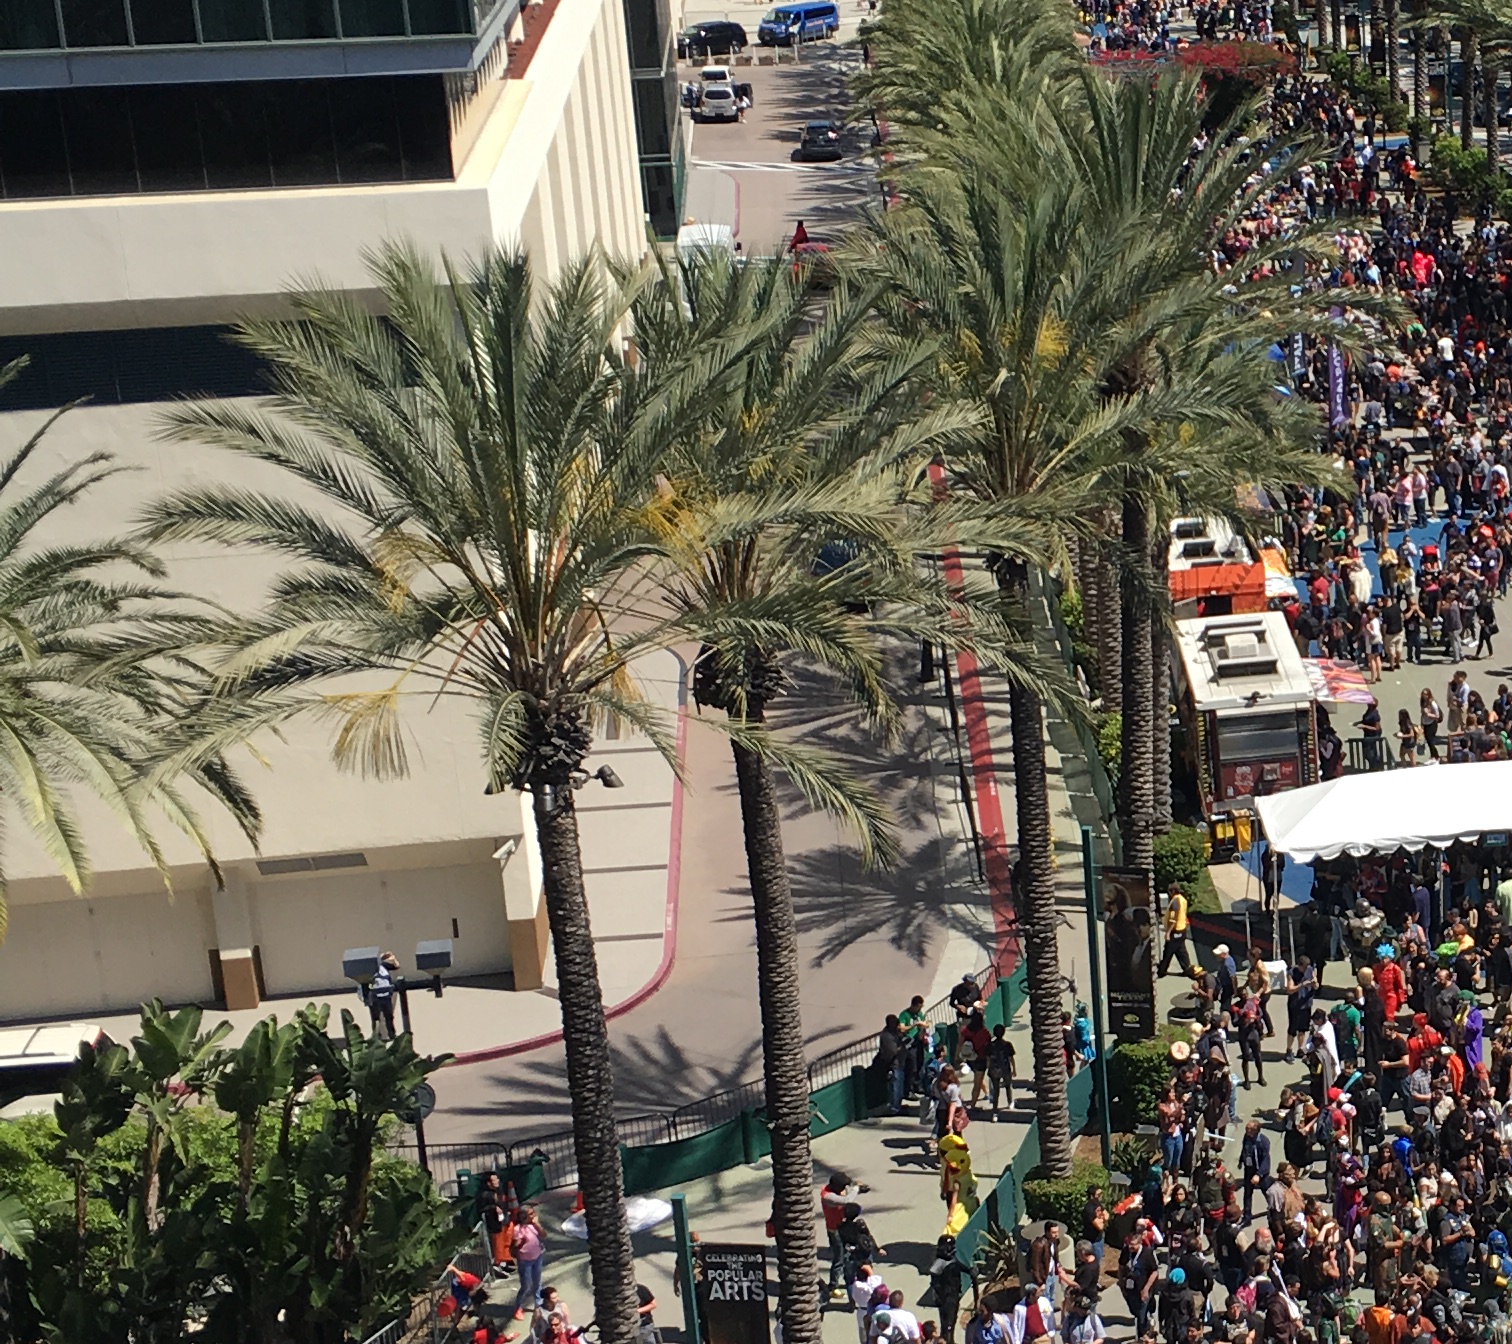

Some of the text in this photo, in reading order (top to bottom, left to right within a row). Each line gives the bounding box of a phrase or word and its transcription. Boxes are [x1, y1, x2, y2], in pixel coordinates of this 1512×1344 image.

[705, 1253, 763, 1263] CELEBRATING
[727, 1262, 744, 1270] THE
[707, 1269, 764, 1282] POPULAR
[709, 1281, 766, 1302] ARTS
